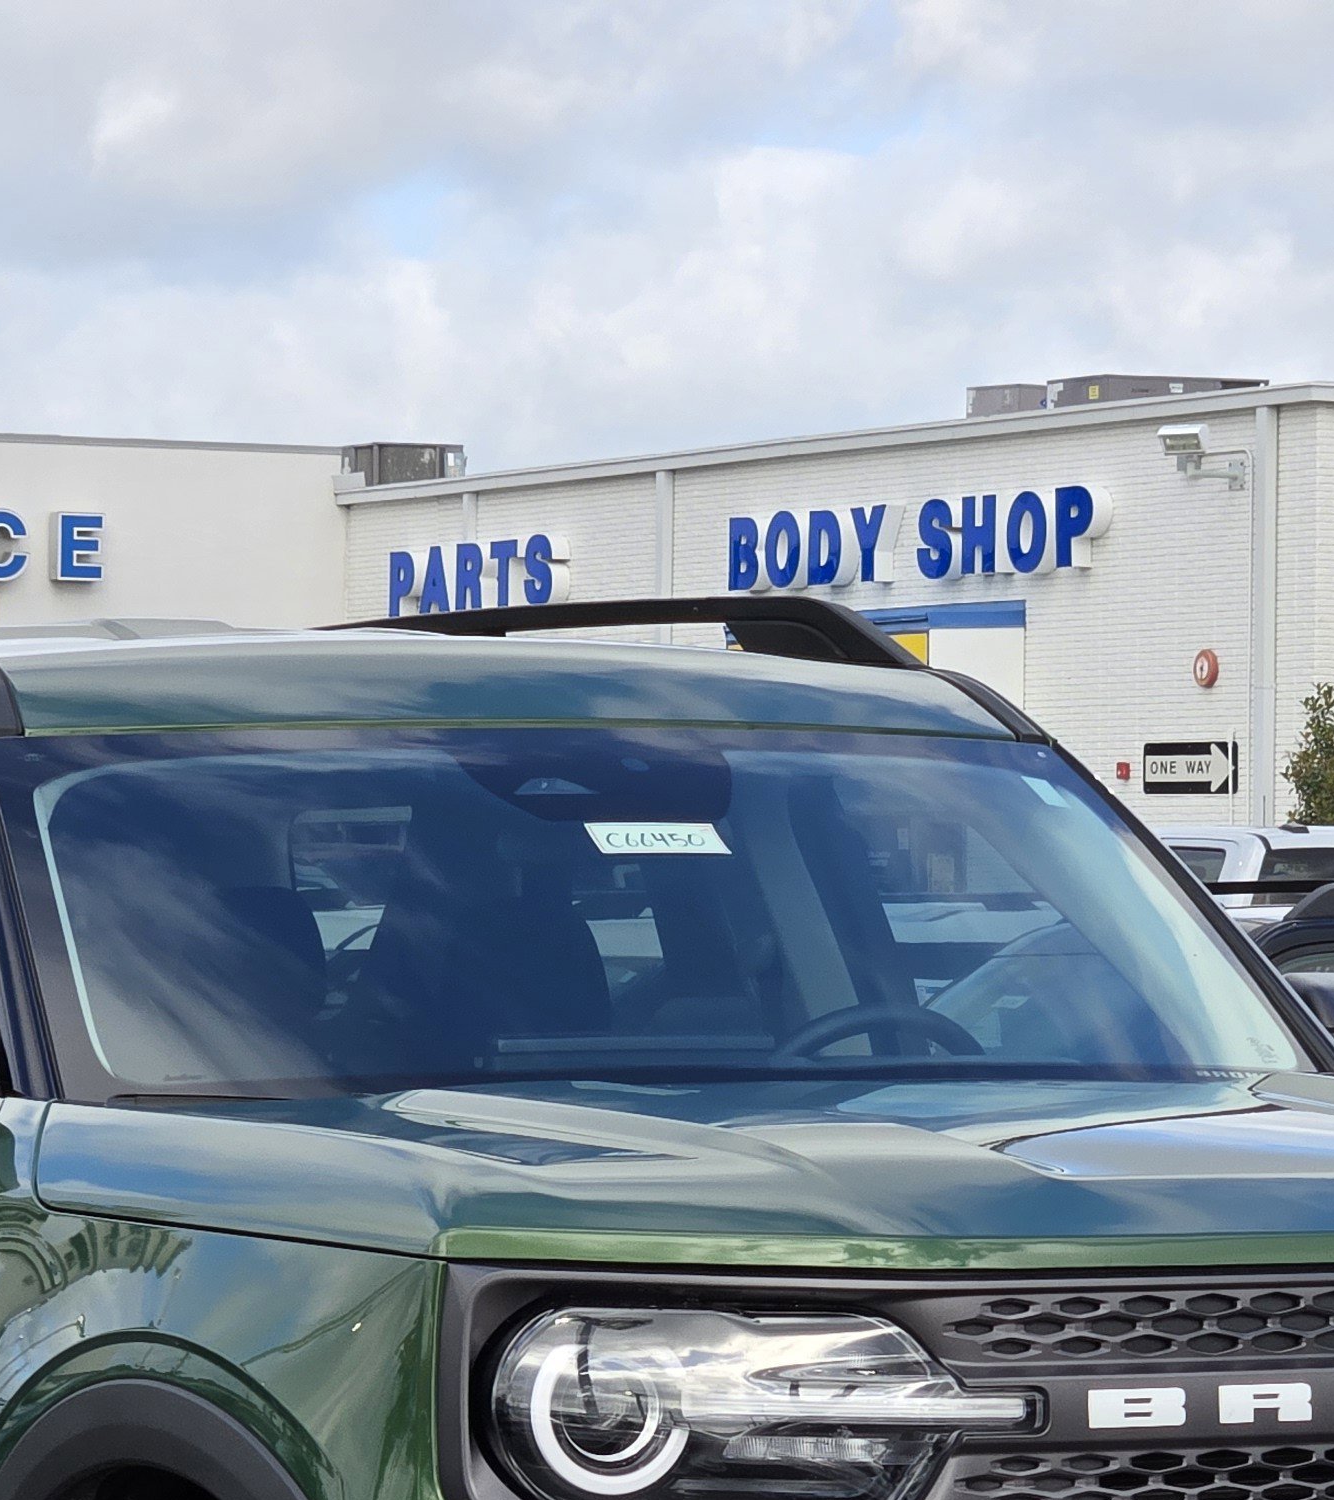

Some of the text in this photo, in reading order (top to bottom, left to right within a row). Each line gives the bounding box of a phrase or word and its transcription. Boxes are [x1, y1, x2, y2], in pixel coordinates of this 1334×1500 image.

[727, 484, 1095, 592] BODY SHOP
[388, 533, 554, 618] PARTS
[1149, 760, 1212, 775] ONE WAY
[605, 831, 706, 849] C66450
